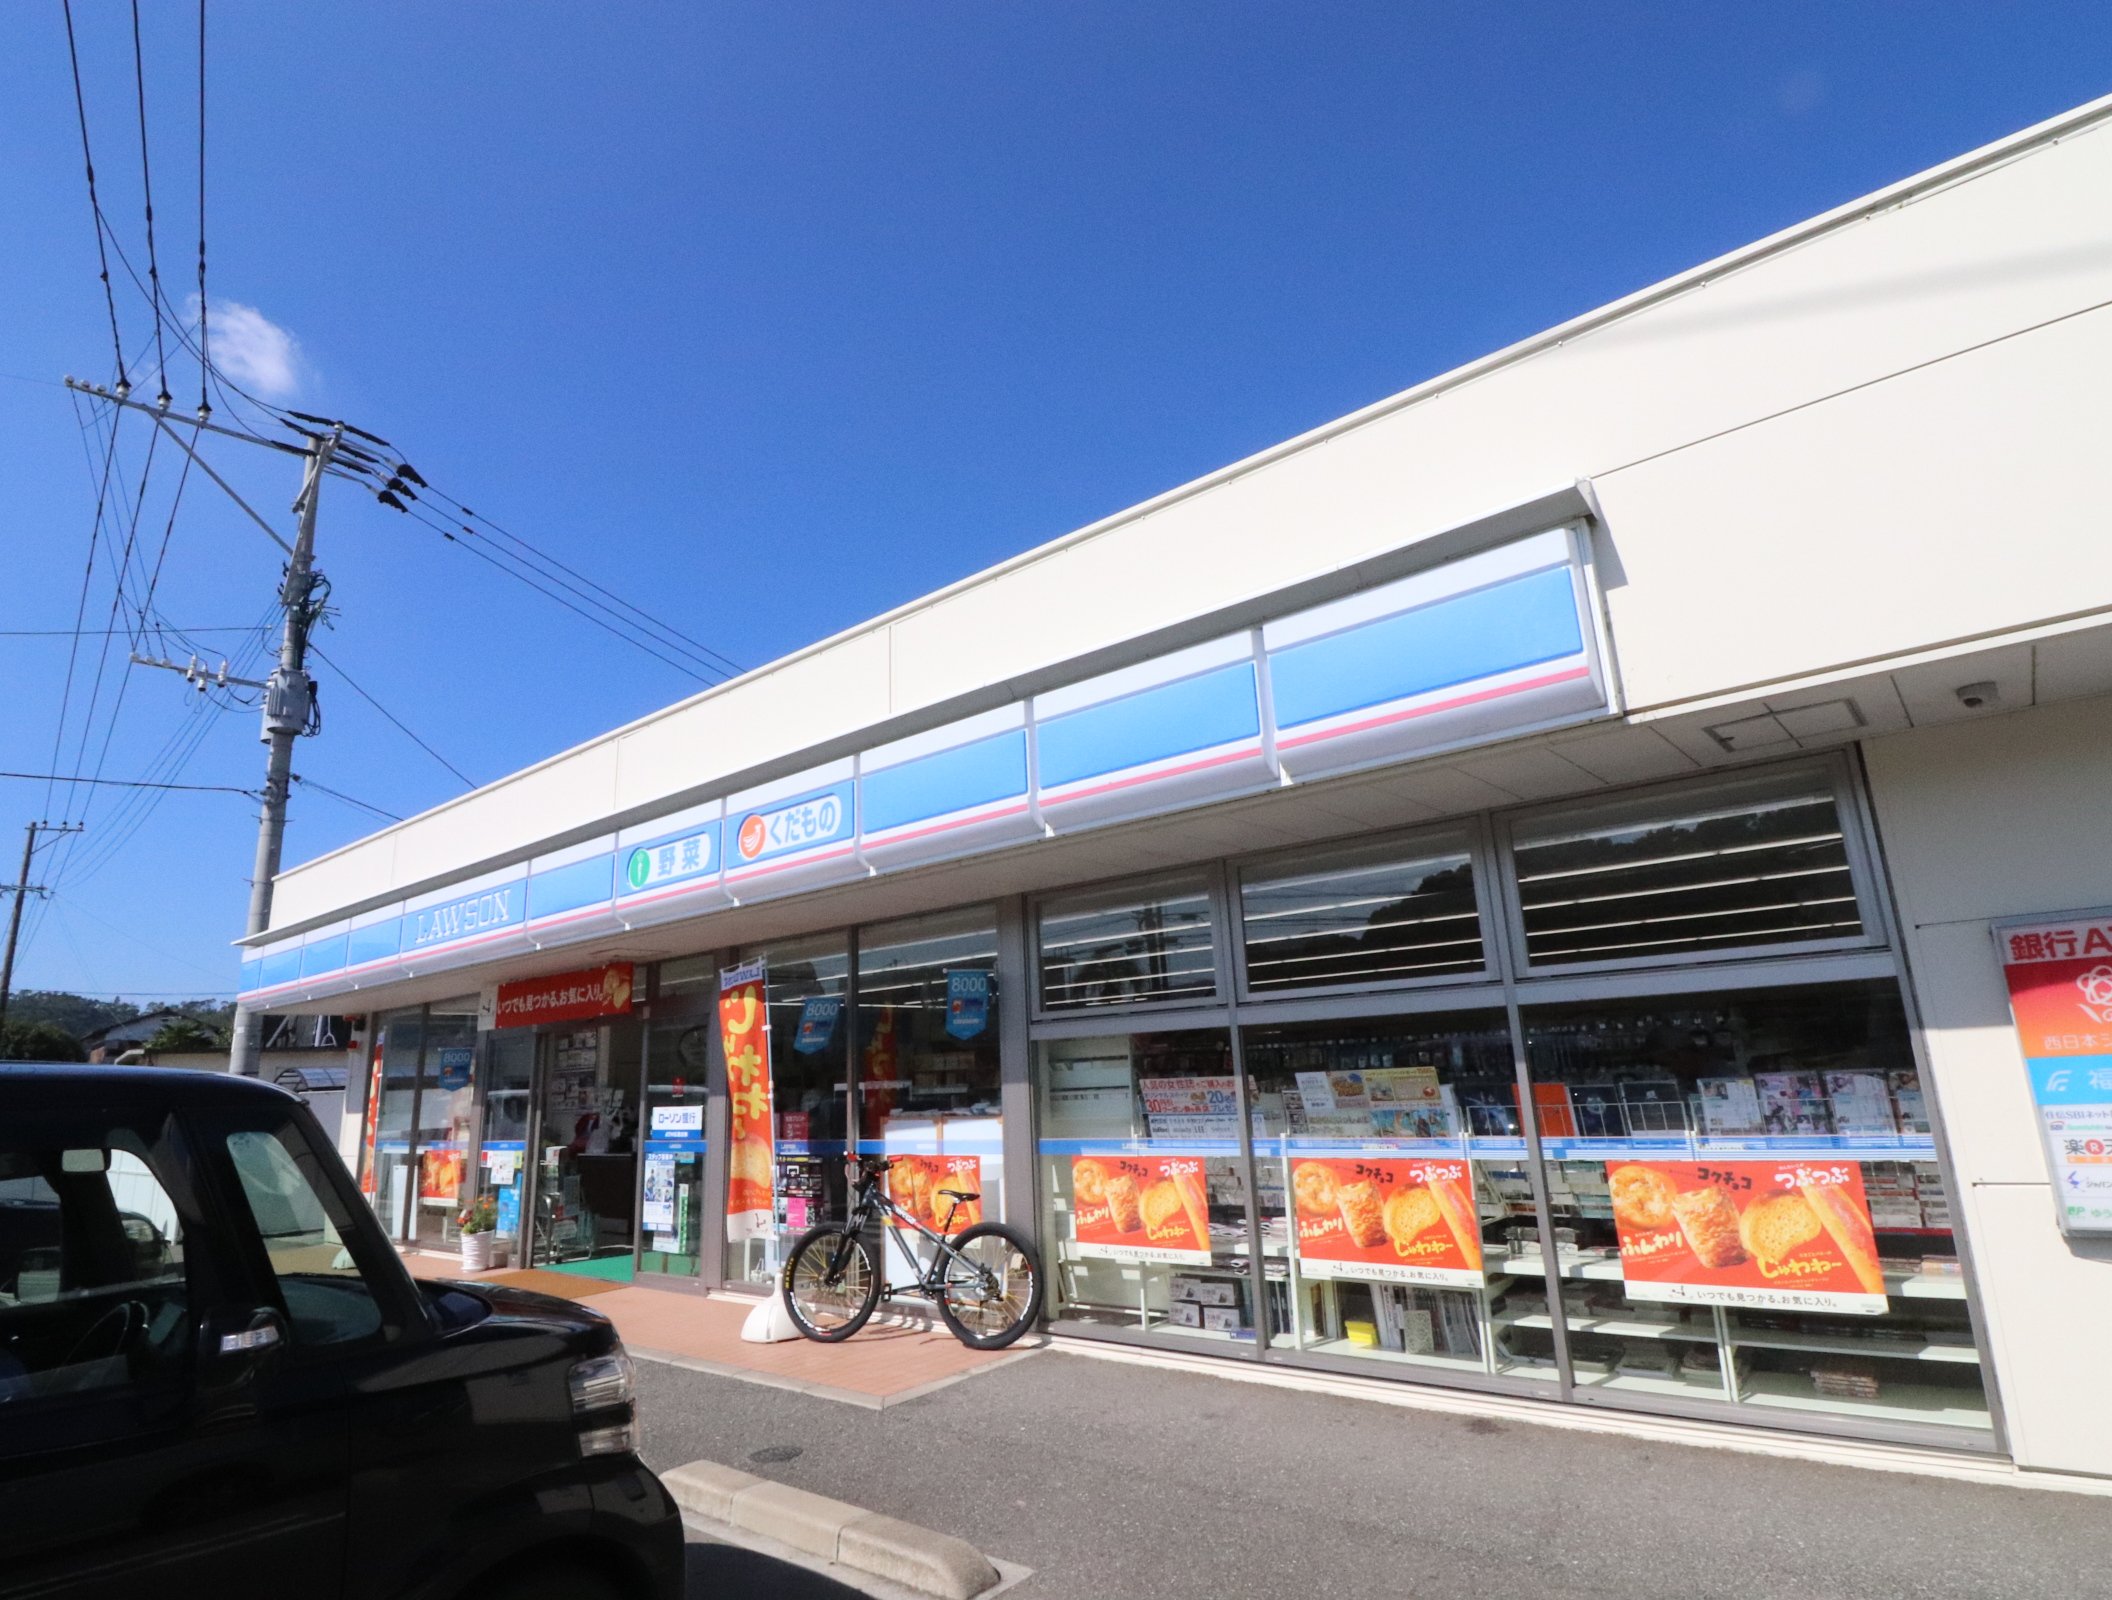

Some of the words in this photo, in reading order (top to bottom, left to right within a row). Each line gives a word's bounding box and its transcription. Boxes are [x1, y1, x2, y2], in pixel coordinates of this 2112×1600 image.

[769, 801, 836, 844] くだもの
[657, 838, 702, 876] 野菜
[415, 889, 510, 943] LAWSON
[2009, 927, 2112, 960] 銀行A
[952, 977, 986, 992] 8000
[806, 1003, 838, 1016] 8000
[444, 1052, 470, 1063] 8000
[1160, 1161, 1198, 1177] つぶつぶ
[1410, 1165, 1462, 1183] つぶつぶ
[1697, 1167, 1753, 1191] コクチョコ
[1774, 1167, 1850, 1189] つぶつぶ
